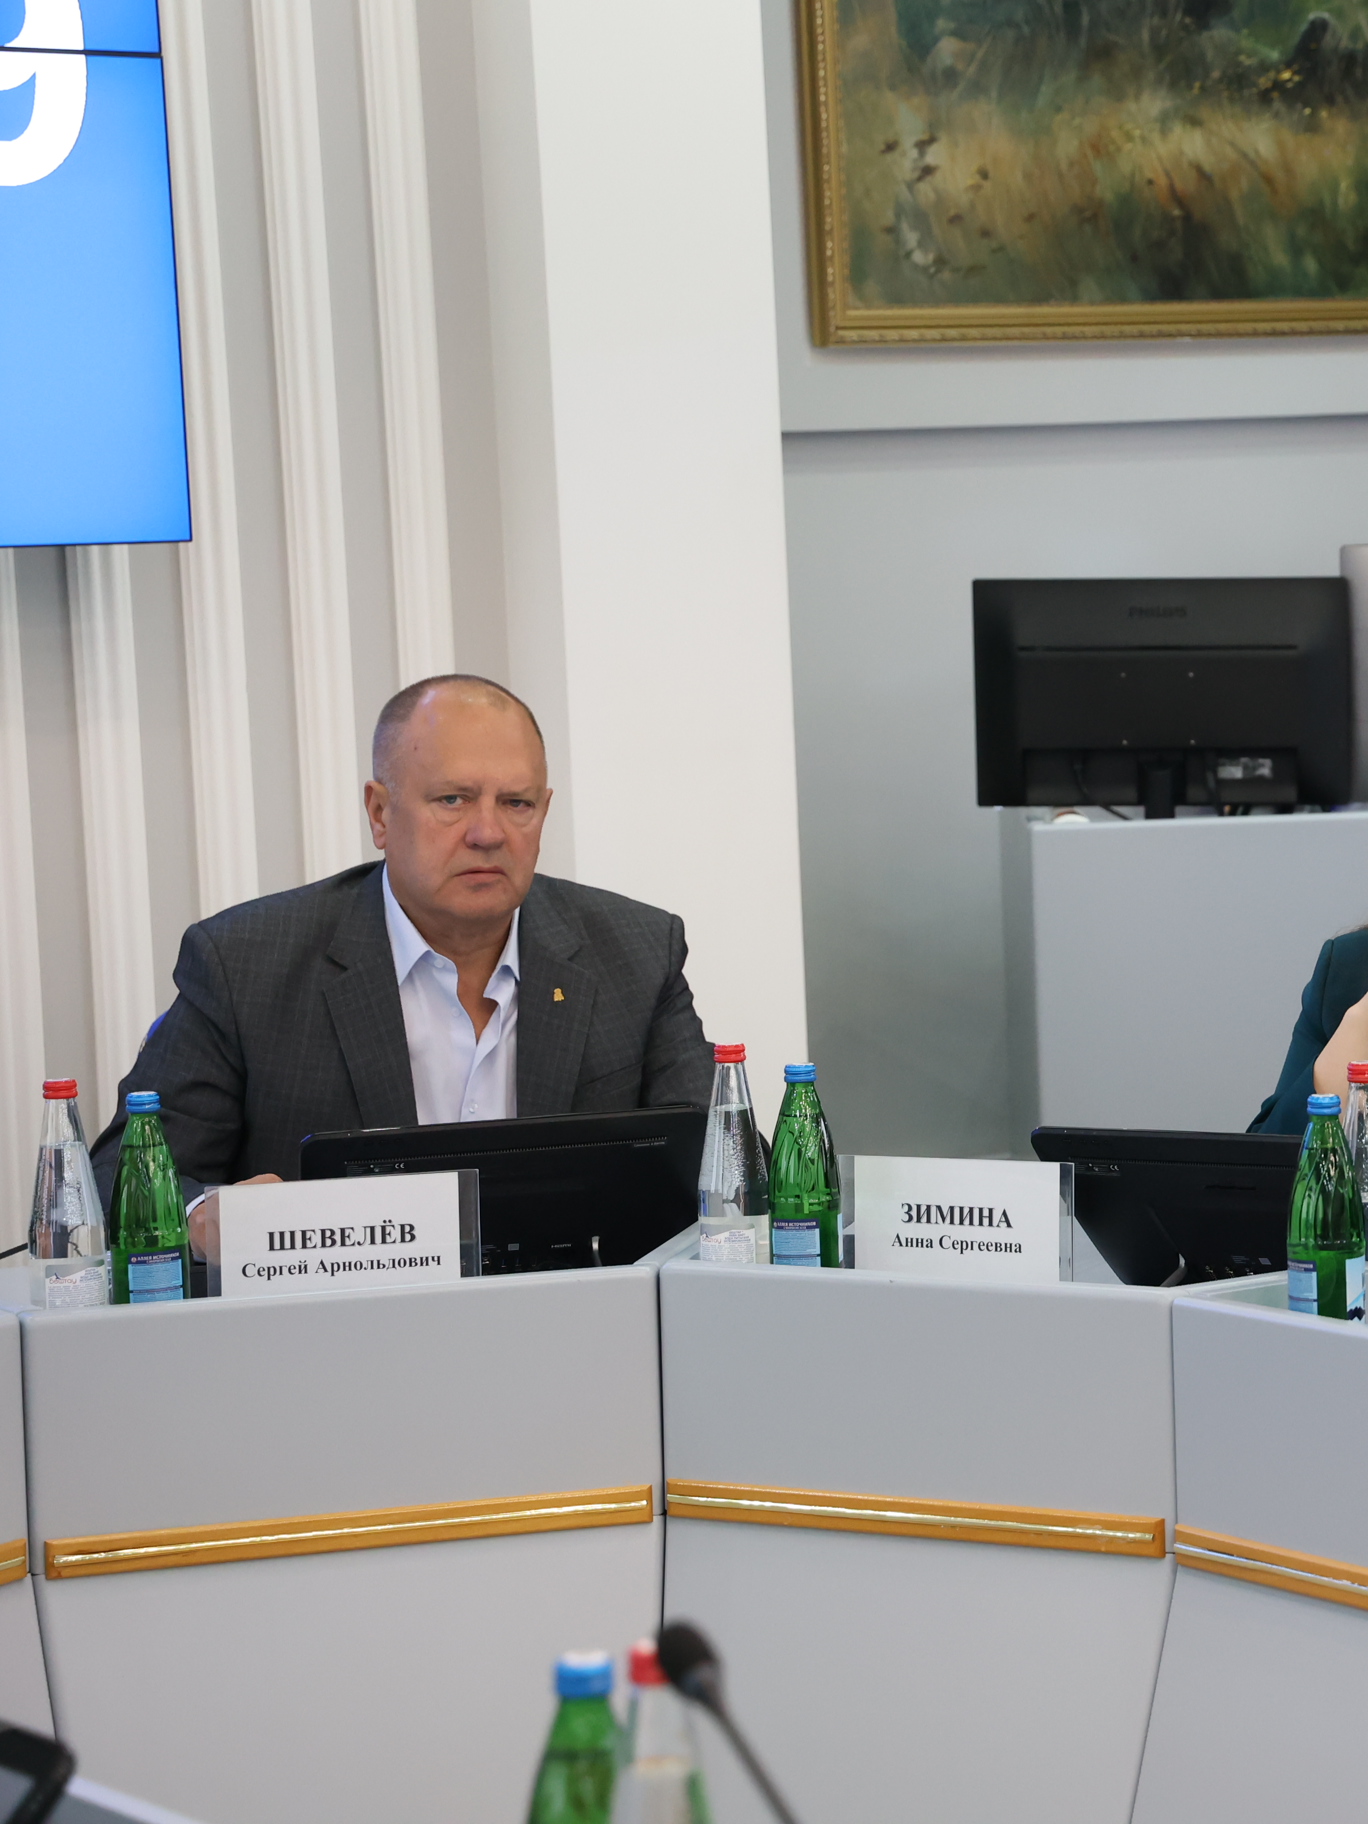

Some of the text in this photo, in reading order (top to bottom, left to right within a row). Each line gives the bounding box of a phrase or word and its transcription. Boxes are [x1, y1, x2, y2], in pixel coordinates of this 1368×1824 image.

[901, 1202, 1013, 1229] ЗИМИНА
[266, 1219, 418, 1252] ШЕВЕЛЁВ
[891, 1233, 1022, 1255] Анна Сергеевна
[241, 1254, 442, 1280] Сергей Арнольдович
